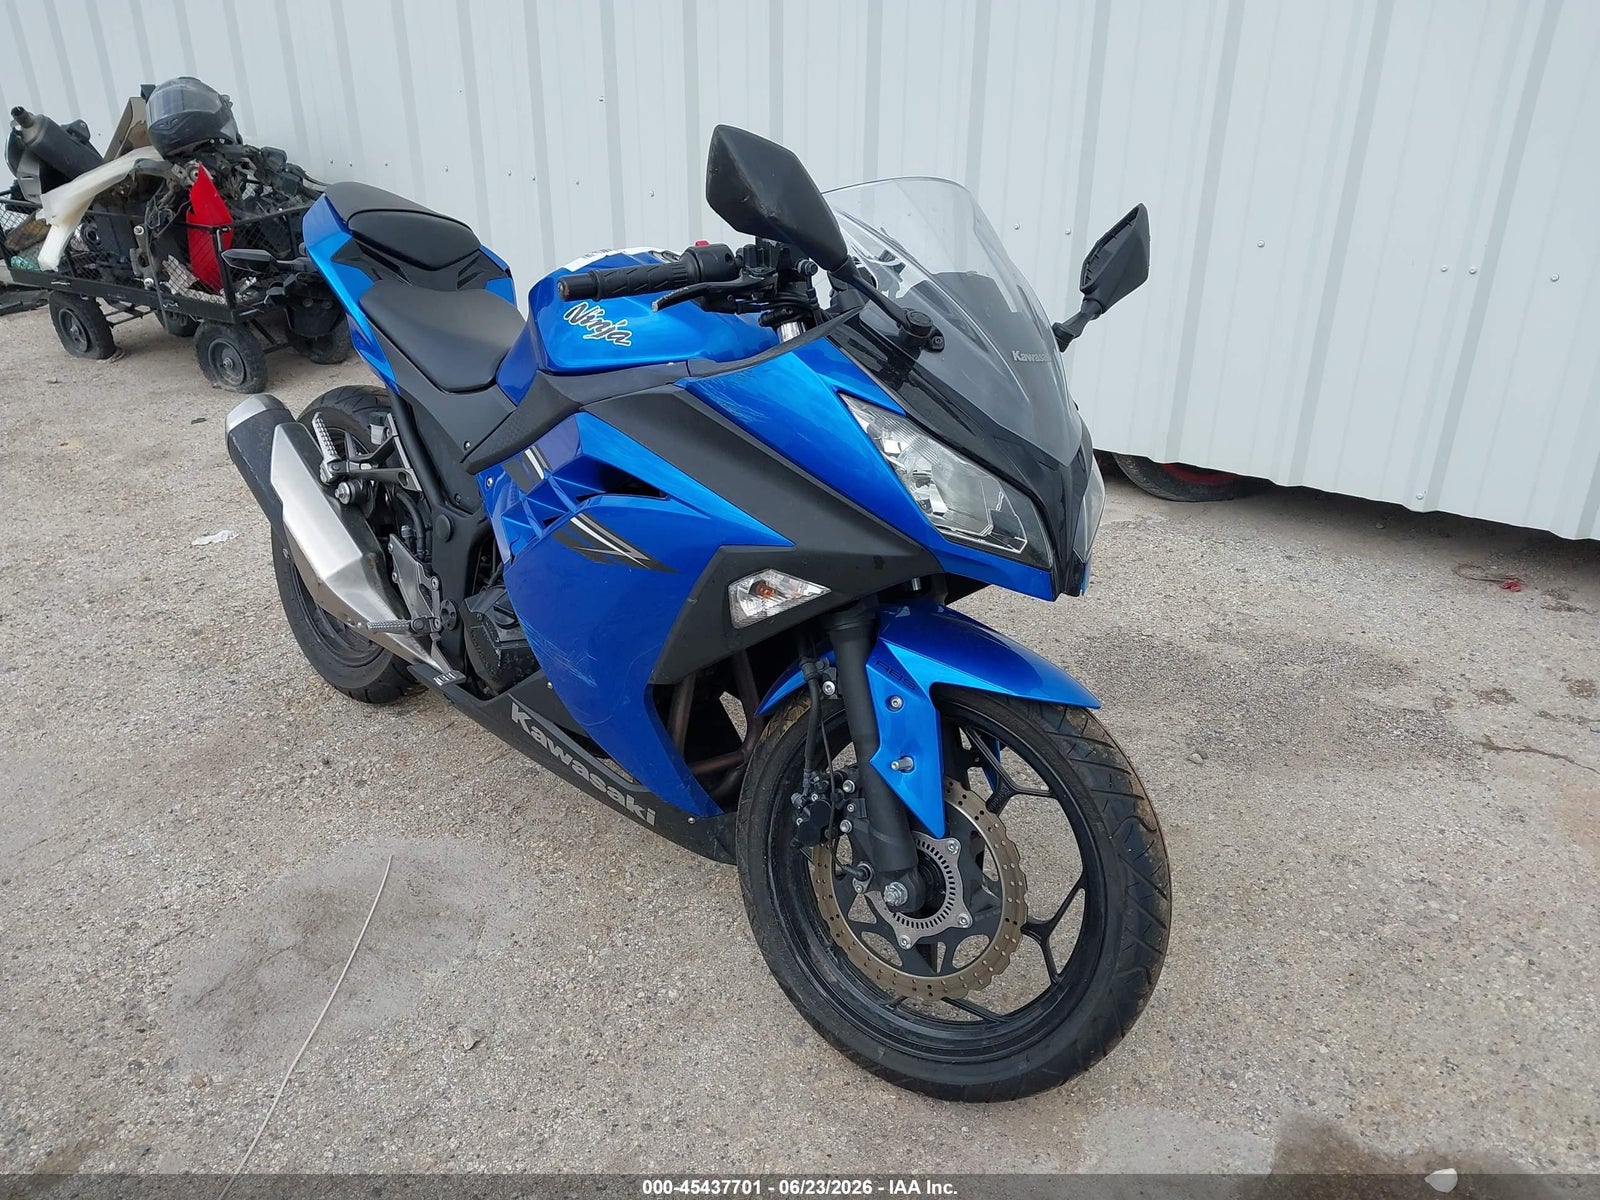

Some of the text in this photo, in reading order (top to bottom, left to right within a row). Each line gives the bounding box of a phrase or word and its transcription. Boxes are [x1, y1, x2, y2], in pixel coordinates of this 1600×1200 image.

[564, 302, 631, 346] Ninja
[875, 659, 917, 690] ABS
[511, 702, 656, 826] Kawasaki
